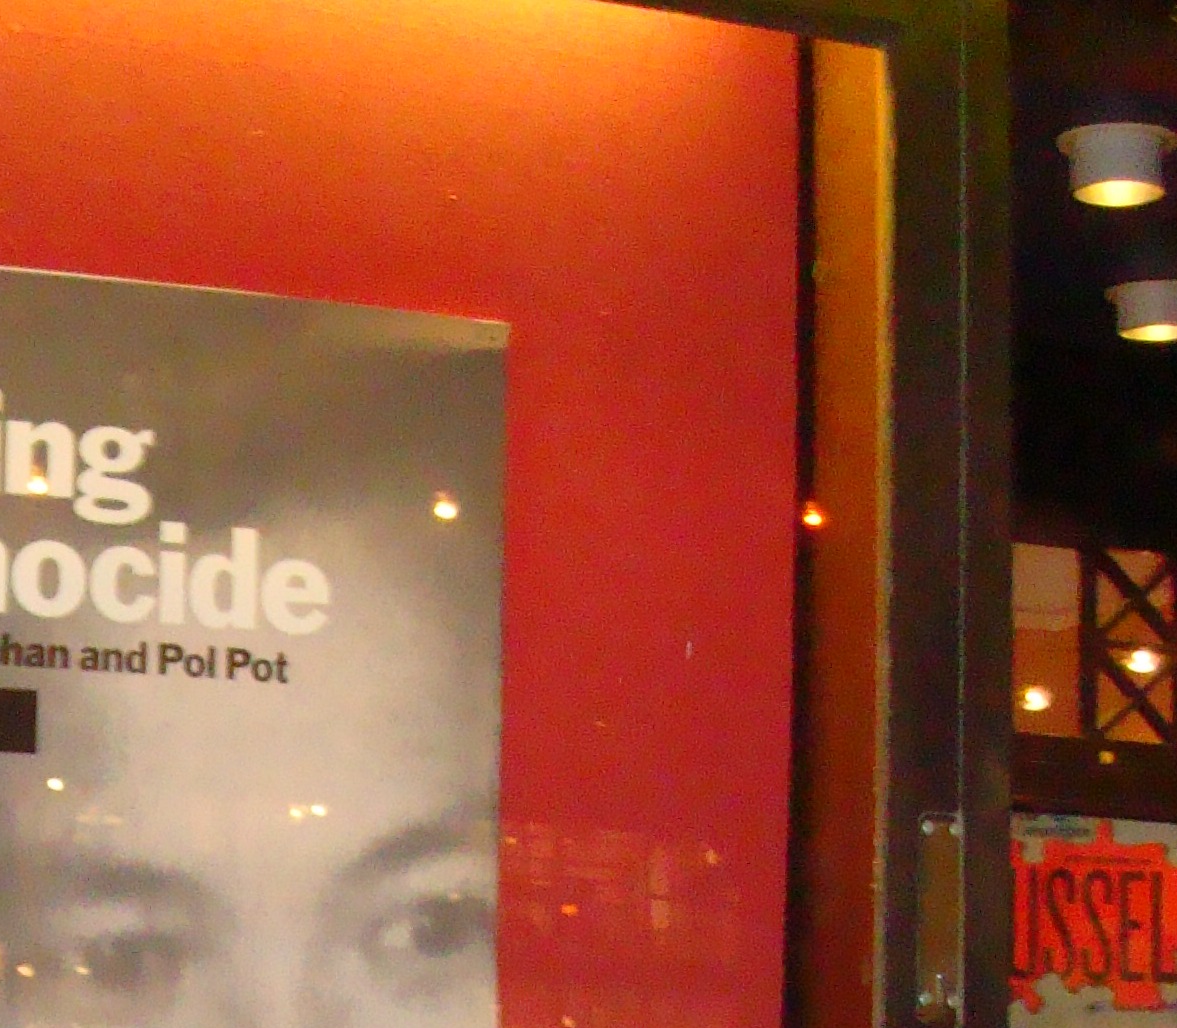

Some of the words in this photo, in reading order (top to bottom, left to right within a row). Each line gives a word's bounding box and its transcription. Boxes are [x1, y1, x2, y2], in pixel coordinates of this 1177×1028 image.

[80, 641, 147, 675] and
[157, 642, 216, 679] Pol
[226, 646, 289, 685] Pot
